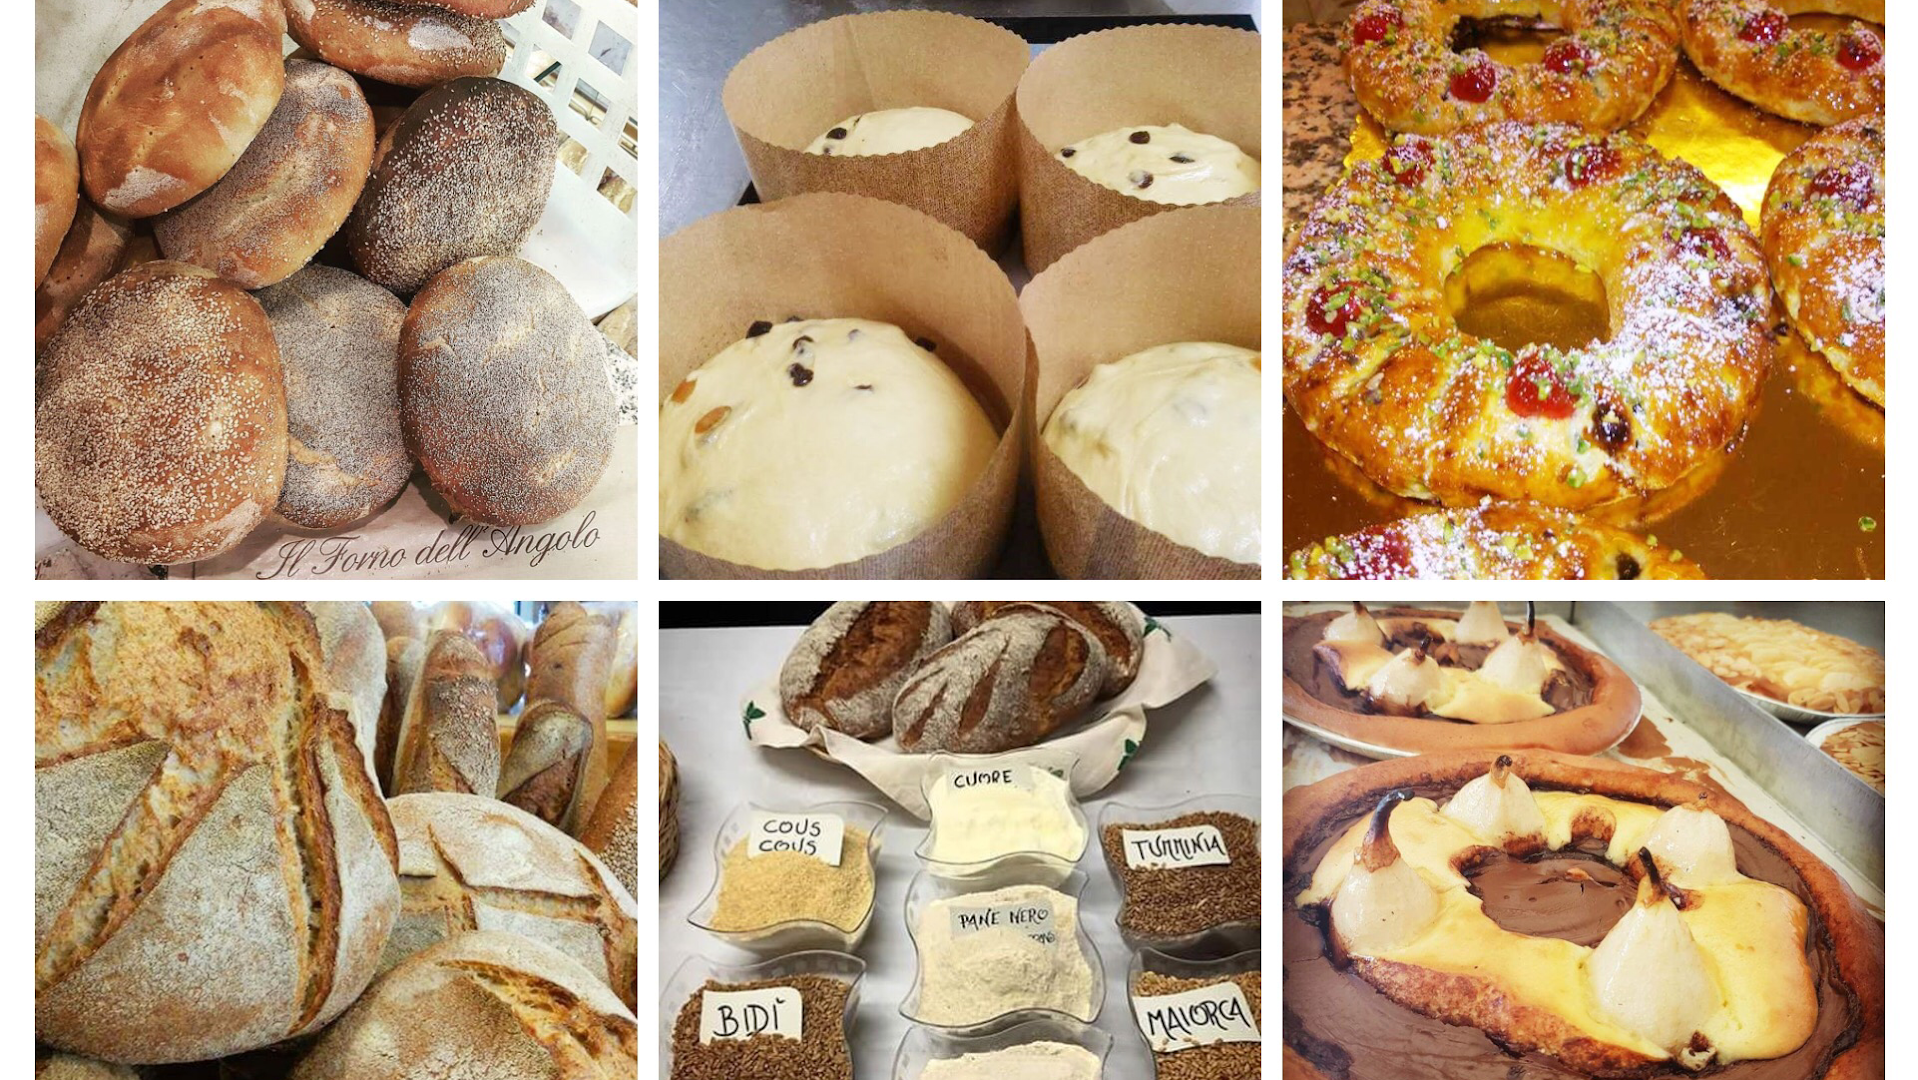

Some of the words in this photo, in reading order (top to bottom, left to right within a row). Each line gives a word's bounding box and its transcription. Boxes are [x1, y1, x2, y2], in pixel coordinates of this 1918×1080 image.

[256, 537, 316, 579] Il
[311, 535, 407, 574] Forno
[763, 818, 821, 837] COUS
[758, 837, 817, 856] COUS
[958, 907, 1001, 931] PANE
[1009, 906, 1049, 925] NERO
[1147, 996, 1252, 1041] MAIORCA
